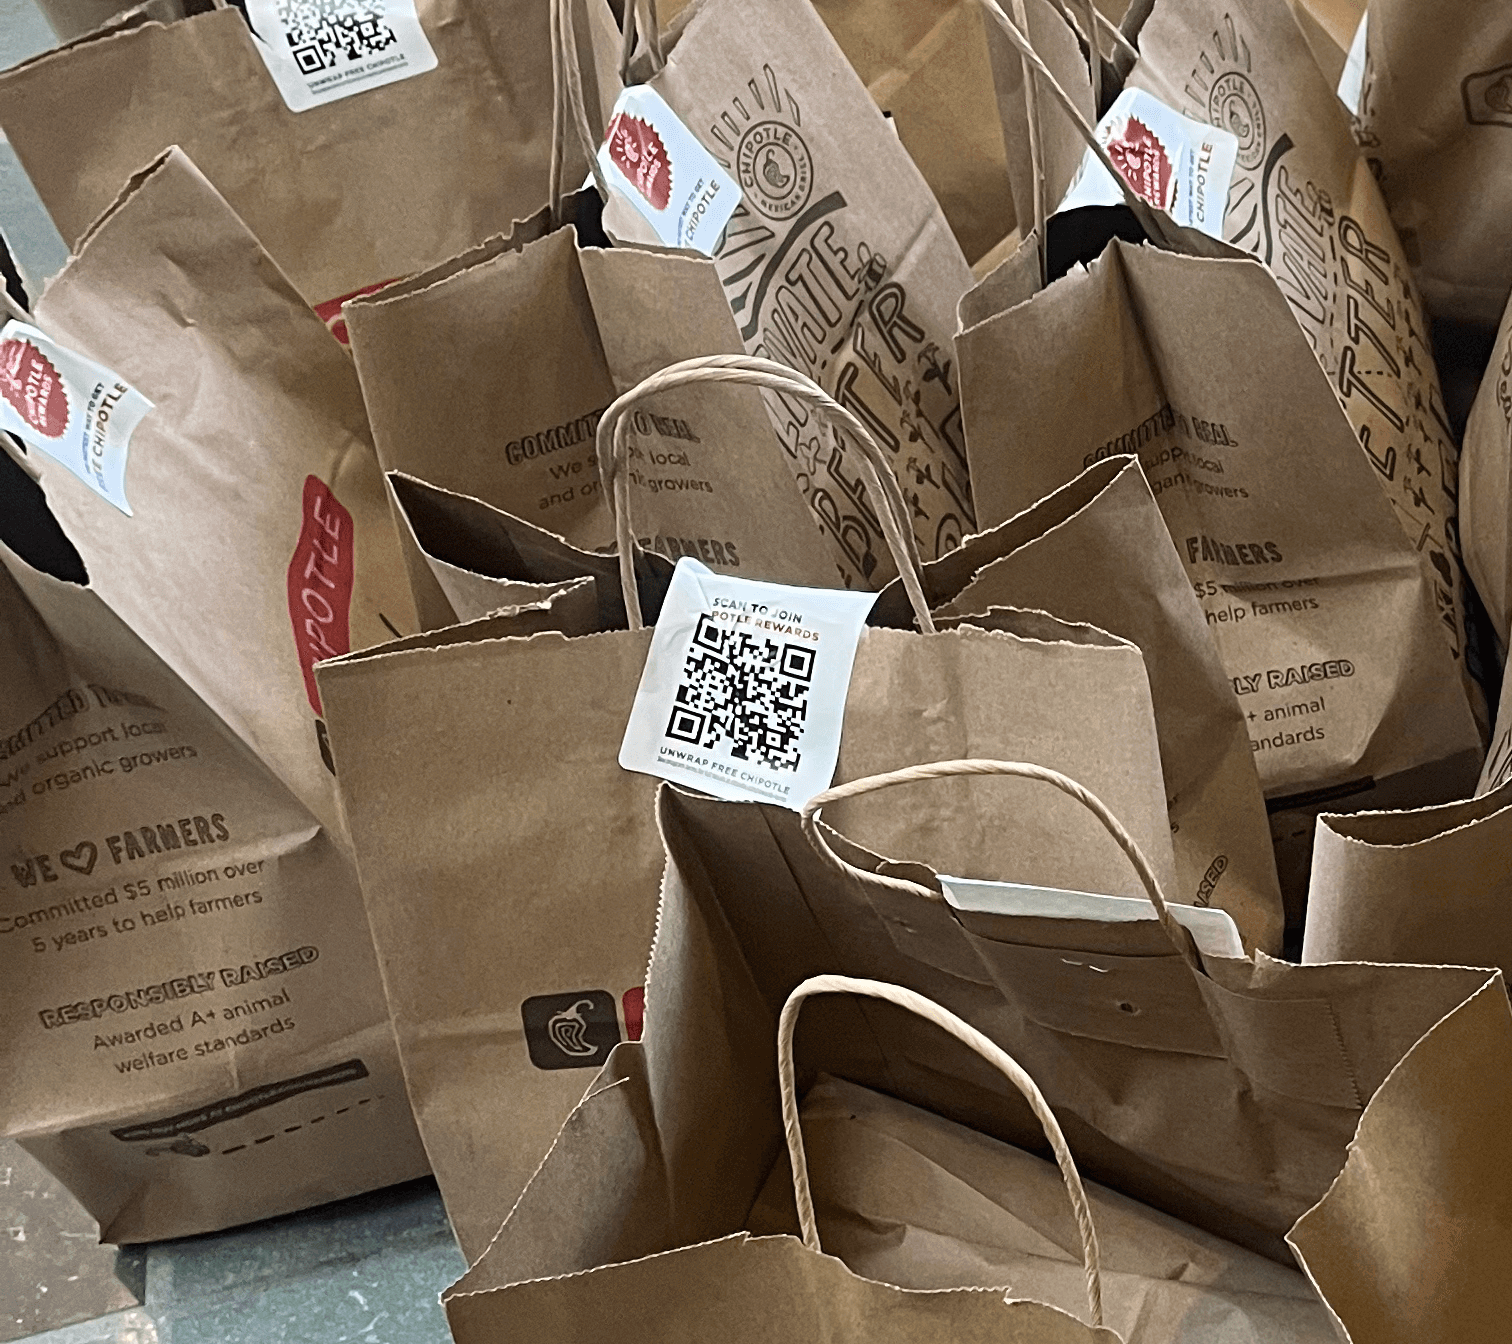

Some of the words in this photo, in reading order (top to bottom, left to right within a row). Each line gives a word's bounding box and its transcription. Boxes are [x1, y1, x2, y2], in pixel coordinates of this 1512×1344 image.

[741, 126, 793, 189] CHIPOTLE
[1195, 141, 1214, 224] CHIPOTLE
[685, 179, 721, 242] CHIPOTLE
[1338, 214, 1404, 482] ETTER
[92, 382, 129, 458] CHIPOTLE
[538, 487, 576, 510] and
[648, 471, 714, 494] growers
[549, 460, 583, 480] We
[1186, 534, 1283, 567] FARMERS
[301, 495, 341, 659] POTLE
[1193, 579, 1219, 601] $5
[711, 609, 750, 625] POTLE
[754, 618, 820, 642] REWARDS
[712, 597, 747, 613] SCAN
[750, 602, 770, 616] TO
[771, 607, 803, 625] JOIN
[1205, 605, 1246, 627] help
[1251, 596, 1320, 619] farmers
[1267, 659, 1356, 690] RAISED
[1264, 696, 1326, 723] animal
[37, 726, 119, 764] support
[1250, 725, 1326, 752] andards
[32, 759, 114, 796] organic
[118, 742, 199, 773] growers
[659, 746, 709, 768] UNWRAP
[711, 762, 738, 779] FREE
[740, 771, 791, 795] CHIPOTLE
[10, 853, 59, 890] WE
[105, 812, 231, 865] FARMERS
[123, 878, 152, 902] $5
[156, 866, 221, 895] million
[222, 858, 266, 882] over
[31, 935, 47, 954] 5
[51, 923, 109, 953] years
[112, 916, 137, 936] to
[139, 902, 187, 930] help
[189, 889, 264, 917] farmers
[38, 971, 217, 1031] RESPONSIBLY
[219, 945, 320, 989] RAISED
[93, 1018, 185, 1052] Awarded
[190, 1008, 218, 1028] A+
[222, 989, 292, 1022] animal
[113, 1046, 190, 1075] welfare
[194, 1016, 297, 1057] standards
